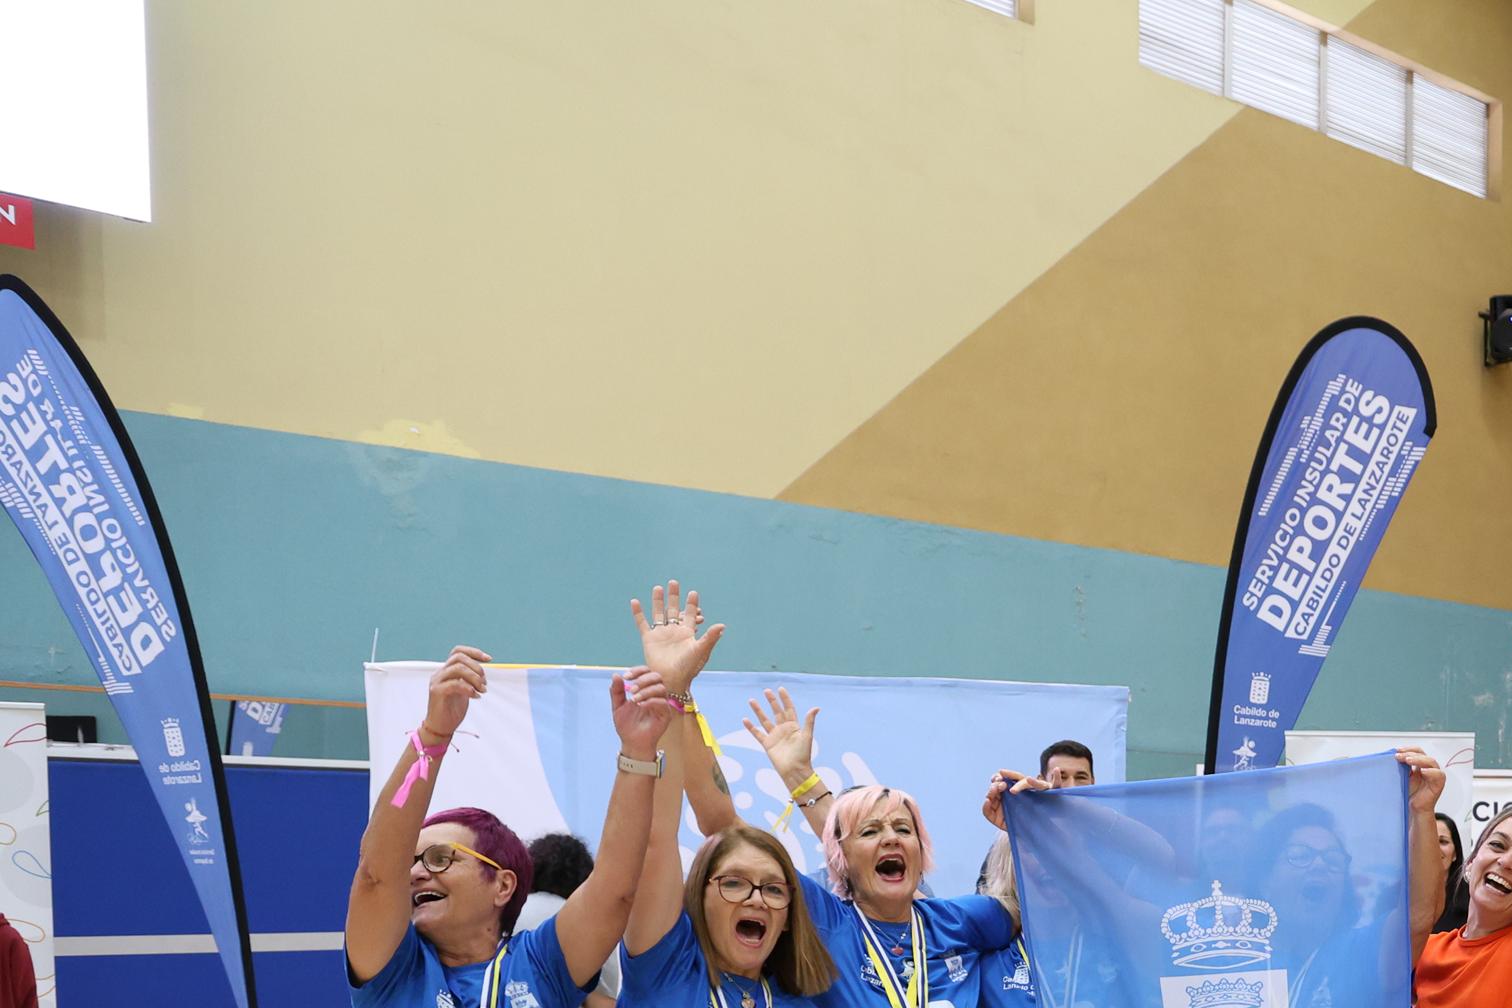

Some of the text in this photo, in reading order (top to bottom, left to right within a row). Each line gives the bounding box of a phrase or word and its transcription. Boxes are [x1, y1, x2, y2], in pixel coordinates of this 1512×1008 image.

[1242, 377, 1364, 612] SERVICIO INSULAR DE
[1256, 388, 1392, 633] DEPORTES
[1293, 408, 1411, 637] CABILDO DE LANZAROTE
[1233, 704, 1280, 718] Cabildo de
[1234, 715, 1278, 728] Lanzarote
